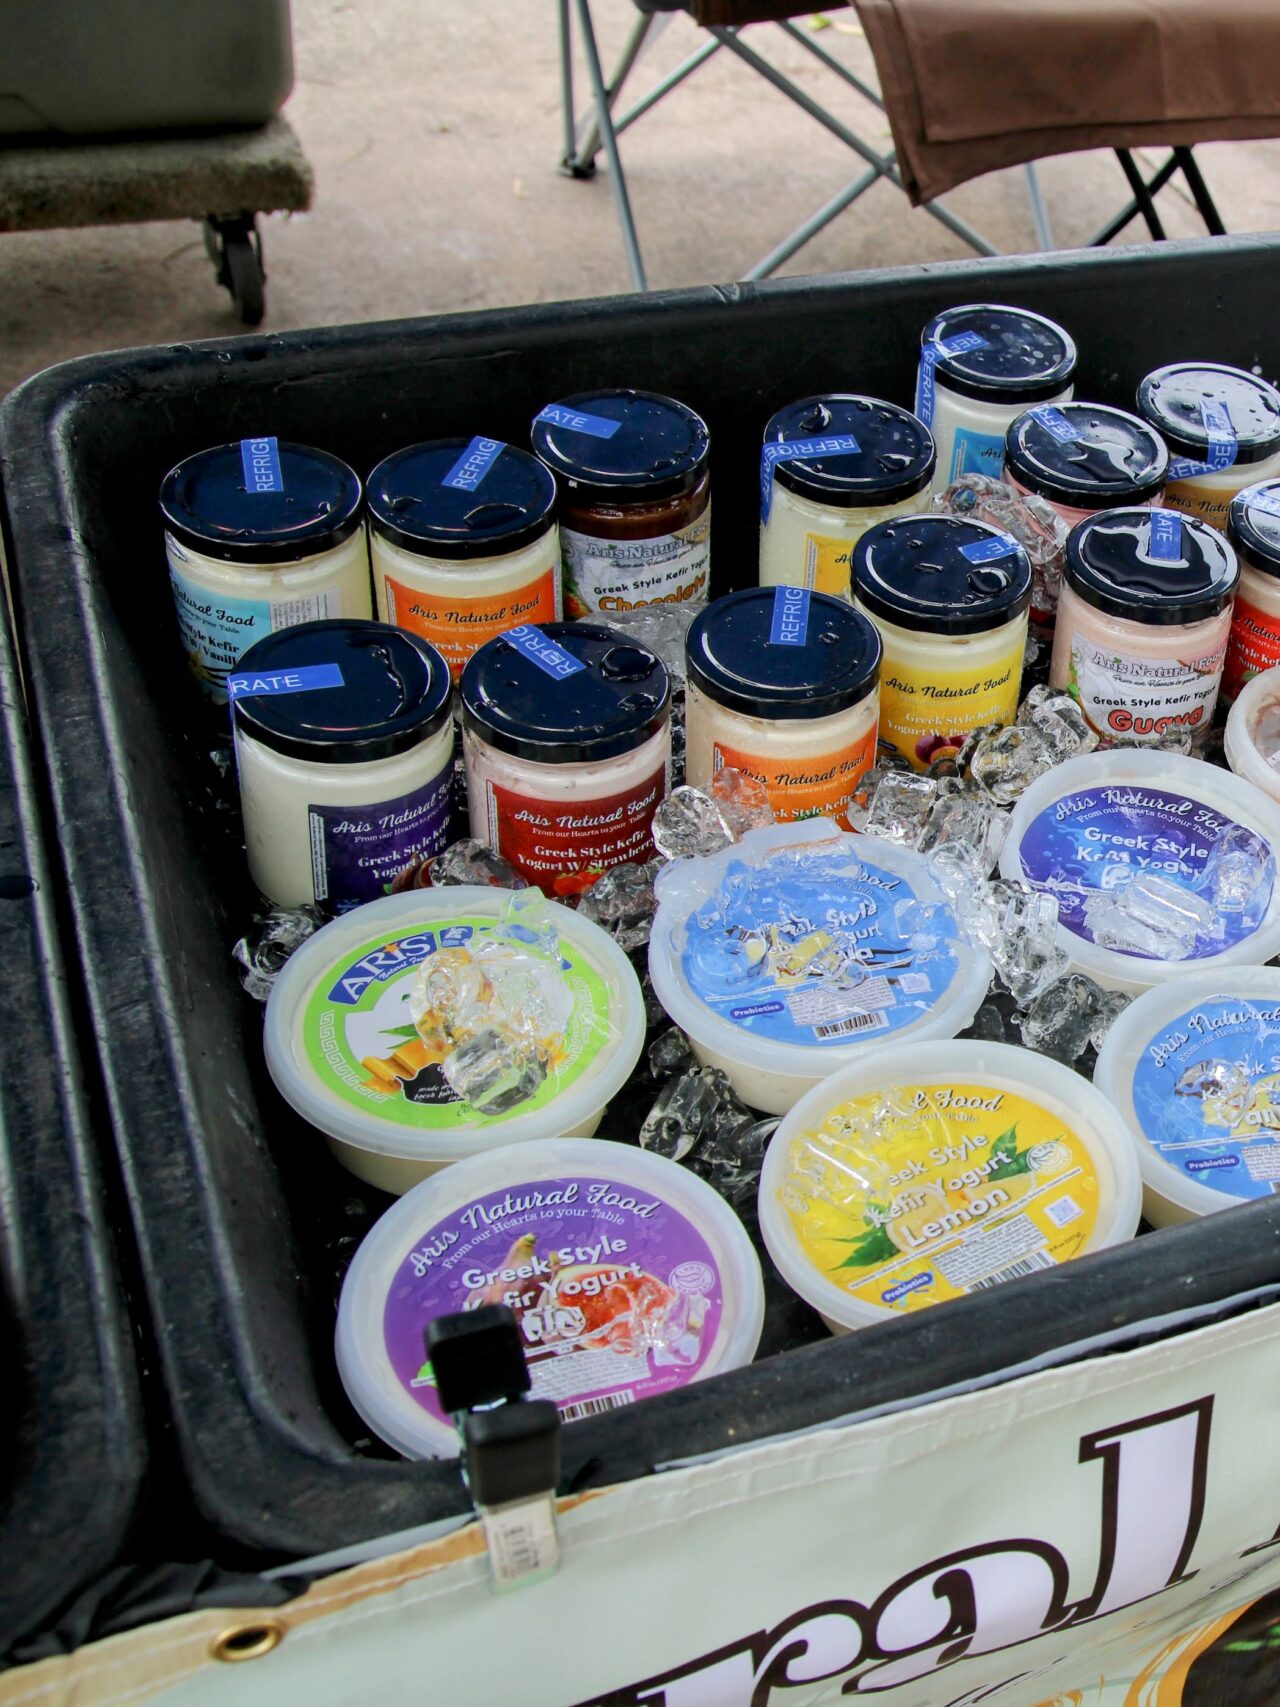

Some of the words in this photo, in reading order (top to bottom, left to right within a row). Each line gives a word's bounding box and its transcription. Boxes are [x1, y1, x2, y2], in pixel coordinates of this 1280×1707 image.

[1198, 501, 1230, 514] Natu
[587, 542, 625, 559] Aris
[628, 534, 688, 559] Natural
[593, 583, 628, 595] Greek
[633, 577, 662, 590] Style
[666, 567, 689, 582] Kefir
[215, 609, 256, 627] Food
[408, 604, 440, 621] Aris
[445, 607, 507, 625] Natural
[510, 592, 542, 616] Food
[203, 646, 238, 666] Vanill
[208, 637, 240, 653] Kefir
[1092, 651, 1129, 673] Aris
[1130, 661, 1199, 679] Natural
[1199, 646, 1227, 671] Food
[885, 677, 916, 694] Aris
[921, 683, 981, 699] Natural
[983, 669, 1012, 691] Food
[1093, 696, 1126, 706] Greek
[1131, 699, 1161, 708] Style
[1165, 694, 1191, 705] Kefir
[887, 719, 927, 736] Yogurt
[905, 712, 943, 725] Greek
[945, 714, 974, 727] Style
[775, 766, 837, 787] Natural
[839, 750, 866, 774] Food
[332, 820, 373, 834] Aris
[378, 792, 437, 829] Natural
[514, 809, 552, 827] Aris
[556, 806, 624, 829] Natural
[627, 787, 657, 815] Food
[791, 806, 823, 818] Style
[1055, 794, 1097, 821] Aris
[1101, 789, 1193, 816] Natural
[354, 834, 378, 843] From
[378, 831, 393, 840] our
[394, 821, 419, 836] Hearts
[532, 827, 554, 835] From
[555, 829, 570, 838] our
[571, 828, 600, 838] Hearts
[609, 821, 627, 833] your
[1076, 810, 1104, 823] From
[1103, 806, 1119, 815] our
[1156, 810, 1168, 821] to
[1167, 815, 1192, 829] your
[1191, 822, 1216, 843] Table
[358, 850, 402, 868] Greek
[403, 836, 432, 856] Style
[517, 852, 563, 871] Yogurt
[588, 836, 655, 871] Strawberry
[533, 845, 578, 858] Greek
[580, 842, 615, 859] Style
[616, 829, 646, 850] Kefir
[1084, 827, 1151, 851] Greek
[1152, 837, 1209, 859] Style
[372, 858, 416, 879] Yogurt
[378, 960, 409, 980] Natural
[733, 1003, 780, 1017] Probiotics
[1149, 1030, 1190, 1068] Aris
[933, 1089, 1005, 1113] Food
[927, 1134, 990, 1166] Style
[1188, 1156, 1236, 1169] Probiotics
[929, 1149, 1014, 1199] Yogurt
[409, 1227, 462, 1278] Aris
[460, 1182, 580, 1231] Natural
[586, 1184, 663, 1221] Food
[899, 1186, 1012, 1248] Lemon
[440, 1243, 471, 1272] From
[468, 1227, 494, 1249] our
[491, 1212, 540, 1235] Hearts
[540, 1209, 556, 1220] to
[555, 1208, 590, 1220] your
[591, 1207, 627, 1227] Table
[461, 1256, 551, 1290] Greek
[558, 1235, 630, 1270] Style
[538, 1262, 646, 1305] Yogurt
[883, 1274, 929, 1301] Probiotics
